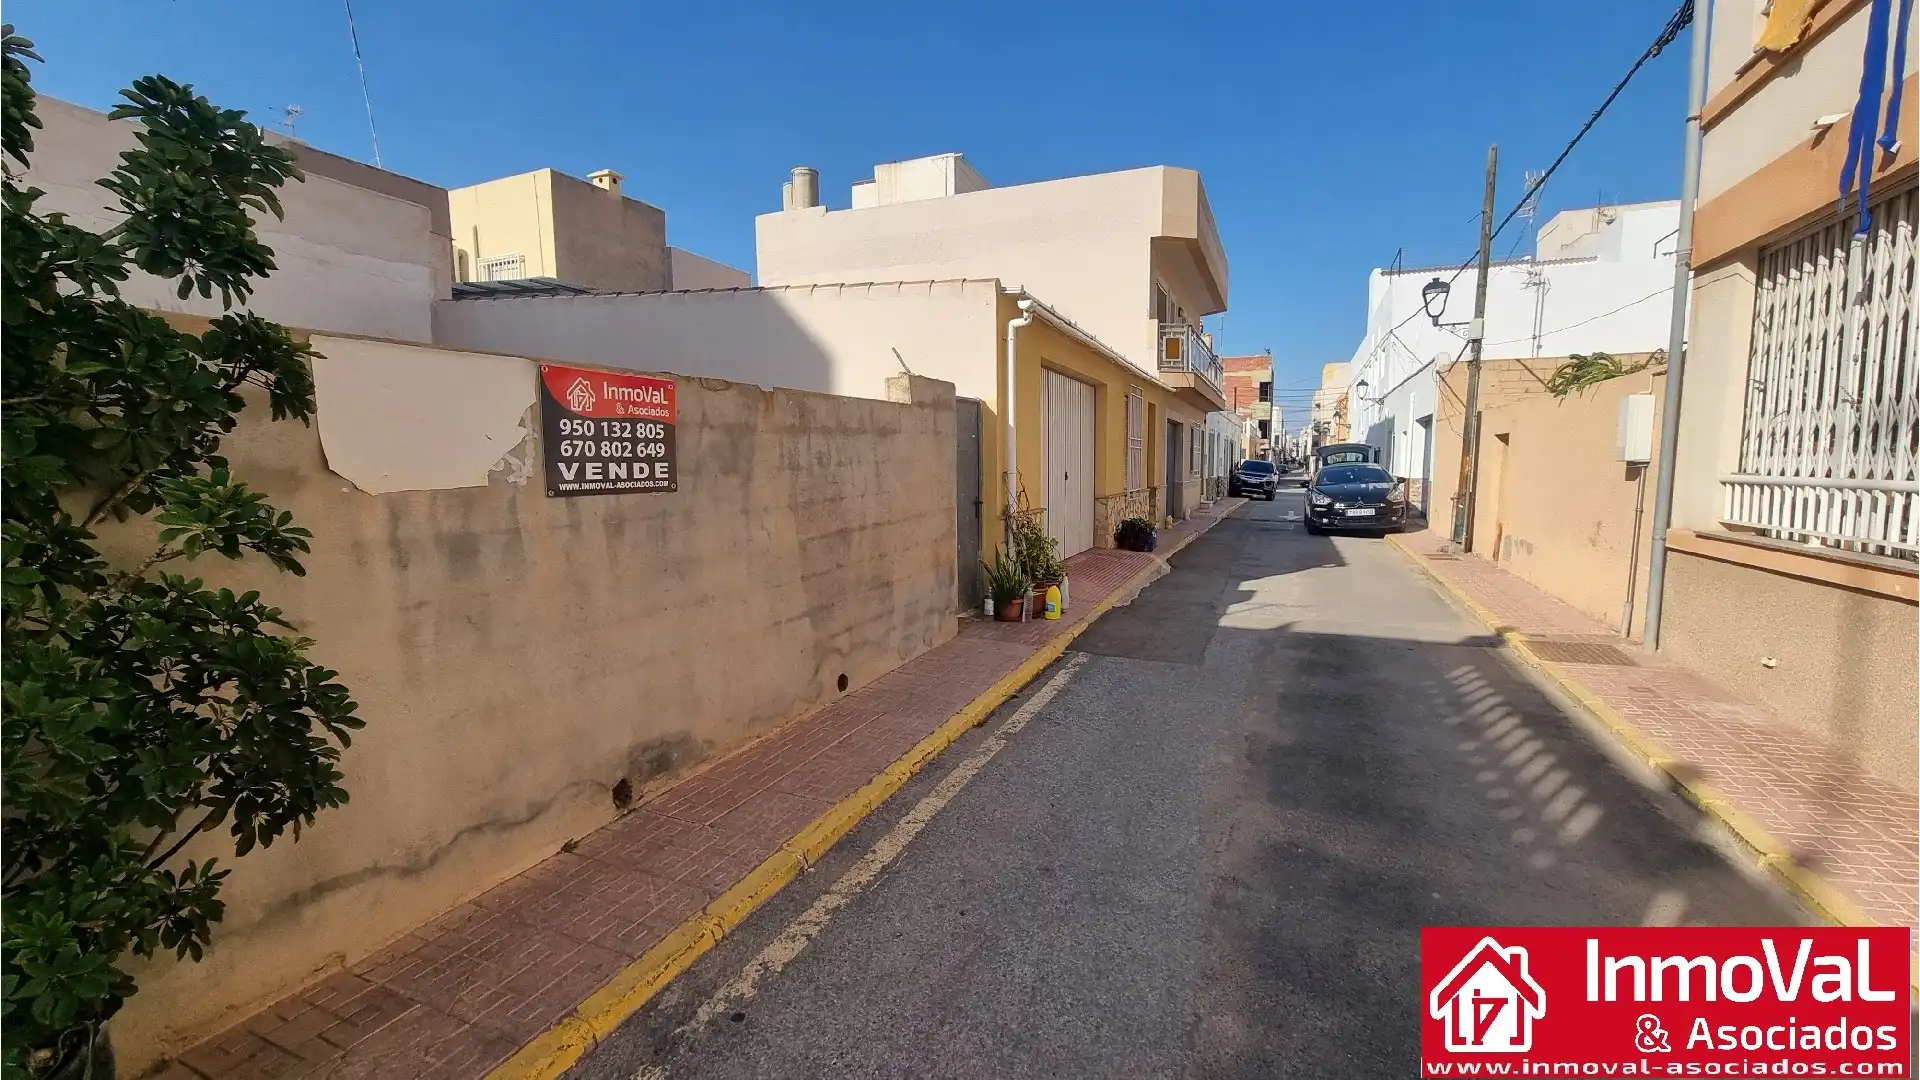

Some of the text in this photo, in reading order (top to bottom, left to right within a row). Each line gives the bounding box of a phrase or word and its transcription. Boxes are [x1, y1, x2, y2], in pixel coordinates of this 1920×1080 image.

[616, 402, 670, 417] & Asociados
[559, 418, 665, 439] 950 132 805
[560, 439, 666, 458] 670 802 649
[557, 462, 669, 481] VENDE
[558, 480, 669, 491] WWW.INMOVAL-ASOCIADOS.COM
